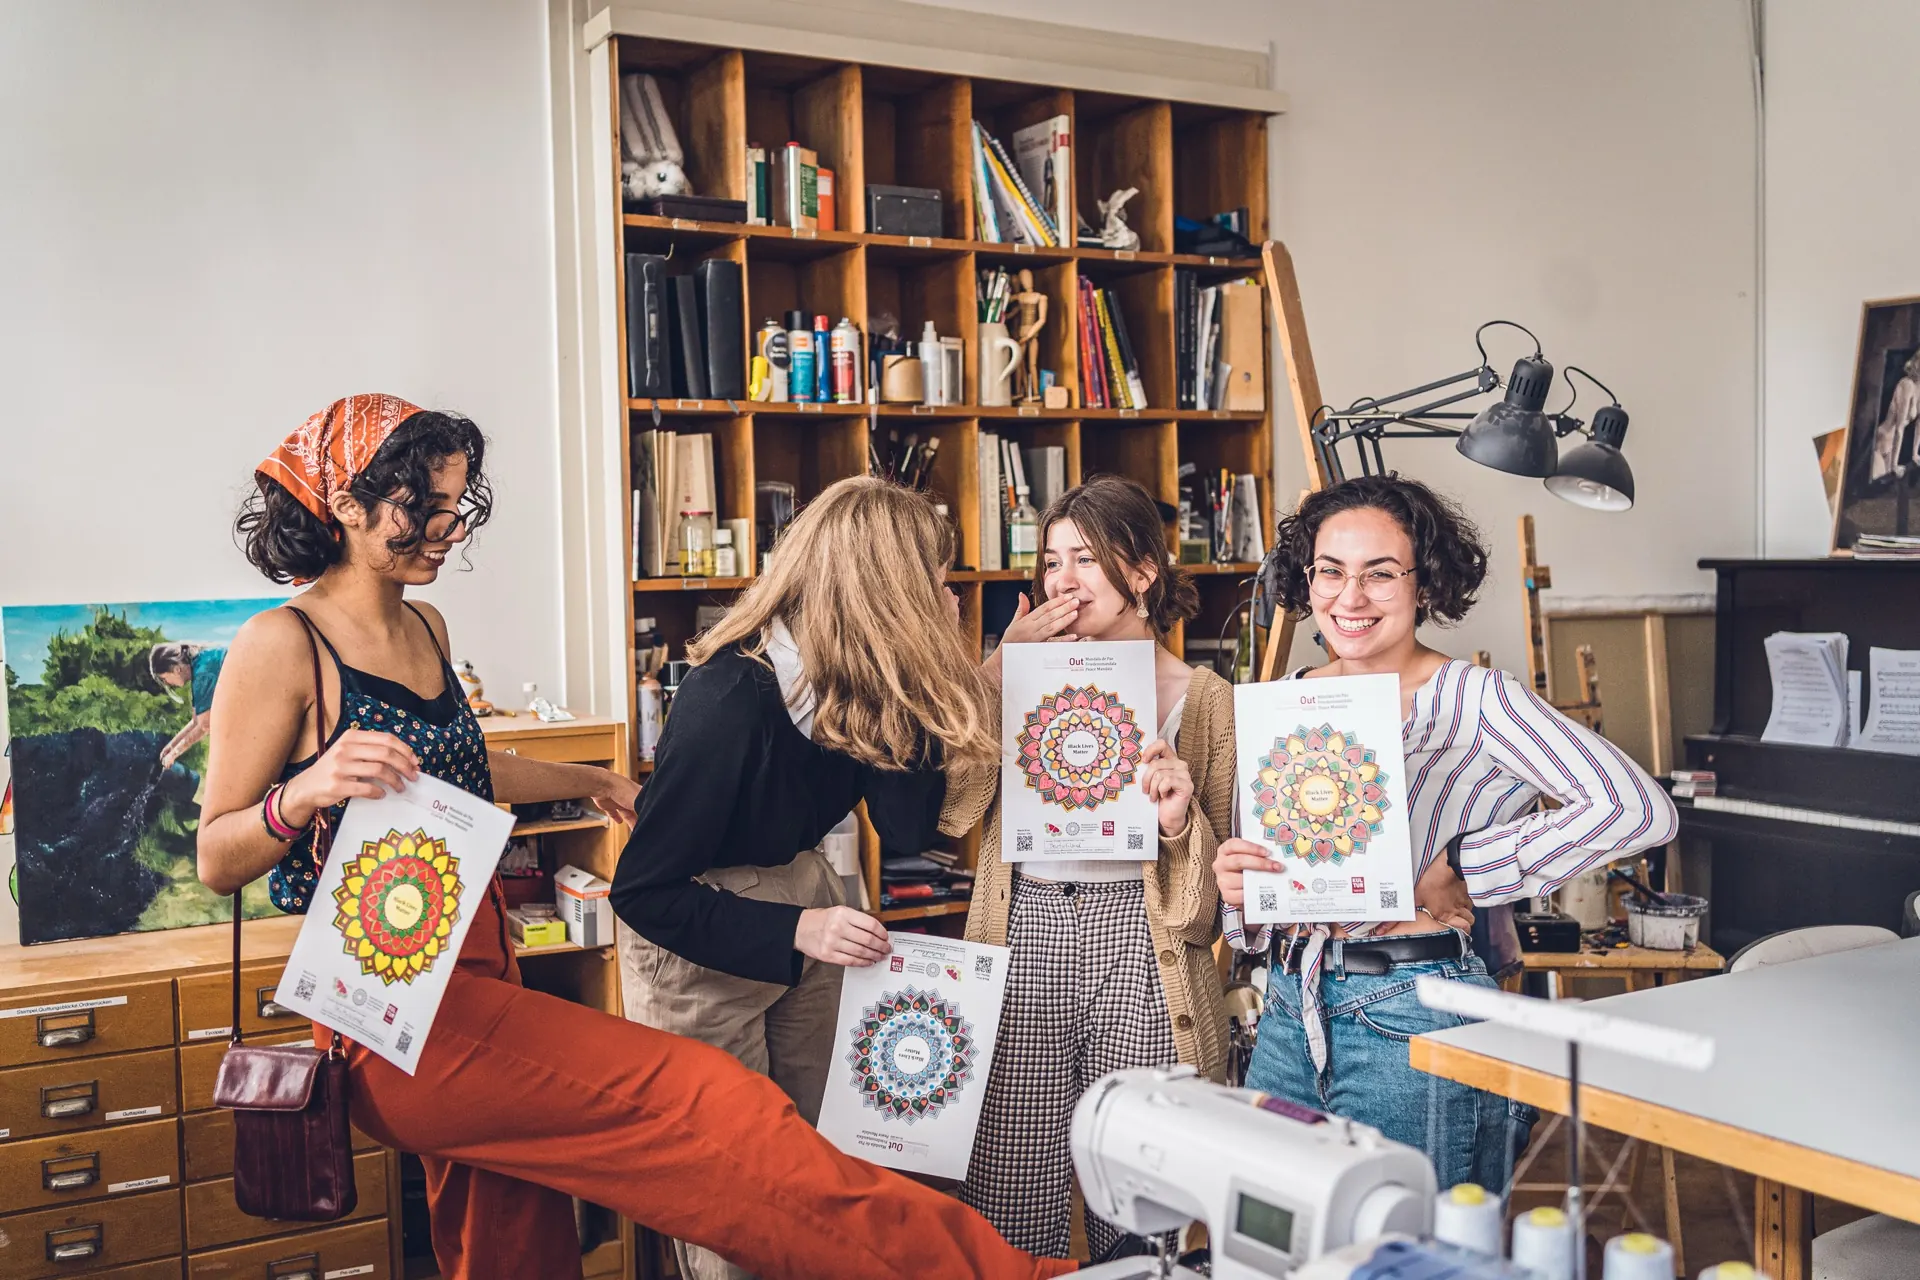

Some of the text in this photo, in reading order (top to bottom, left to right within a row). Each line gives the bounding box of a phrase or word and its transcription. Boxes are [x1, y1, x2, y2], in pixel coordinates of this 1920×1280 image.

[1069, 657, 1084, 666] Out
[1300, 696, 1315, 704] Out
[431, 799, 449, 813] Out
[888, 1142, 904, 1152] Out
